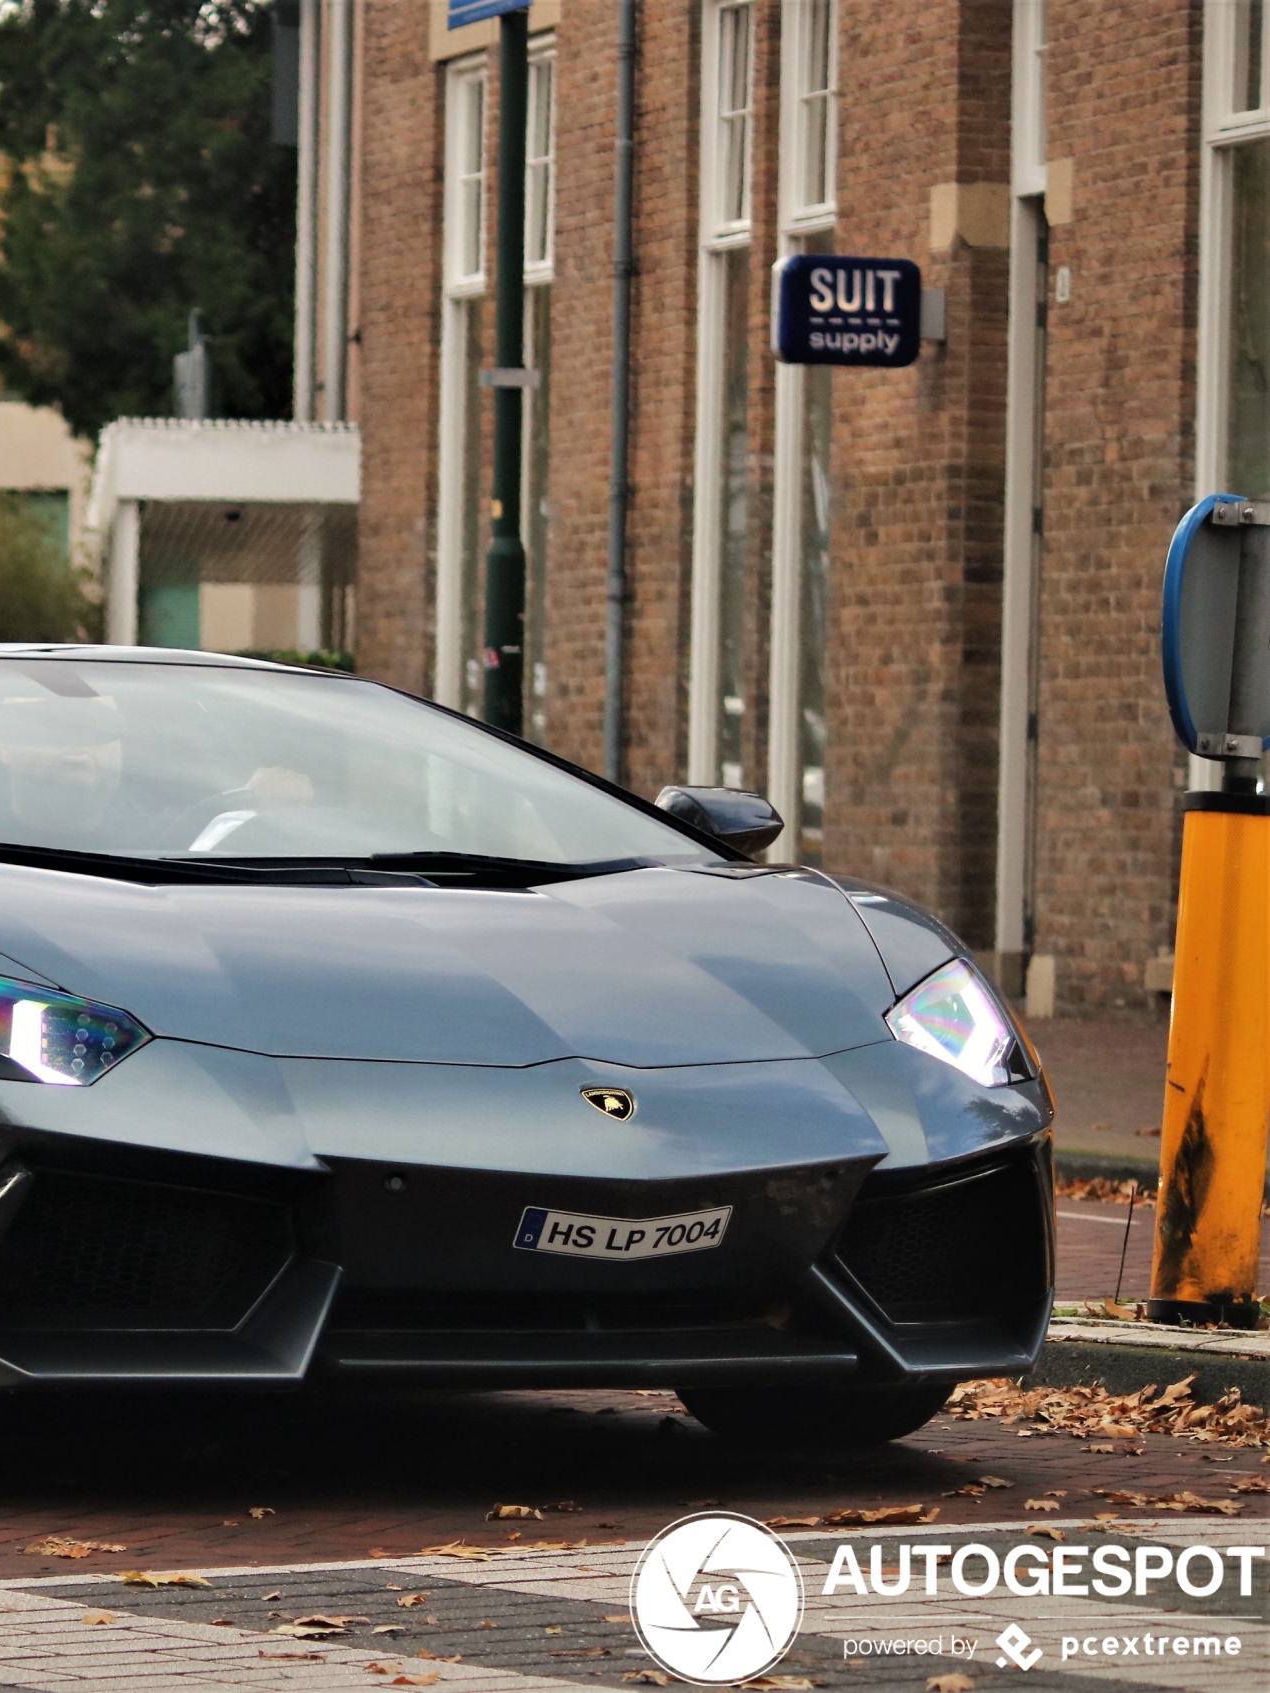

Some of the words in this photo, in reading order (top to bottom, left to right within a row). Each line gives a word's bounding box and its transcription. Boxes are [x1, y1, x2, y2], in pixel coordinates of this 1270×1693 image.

[809, 267, 902, 313] SUIT
[809, 329, 901, 356] supply
[523, 1233, 533, 1243] D
[547, 1221, 597, 1248] HS
[605, 1228, 646, 1252] LP
[652, 1217, 722, 1249] 7004
